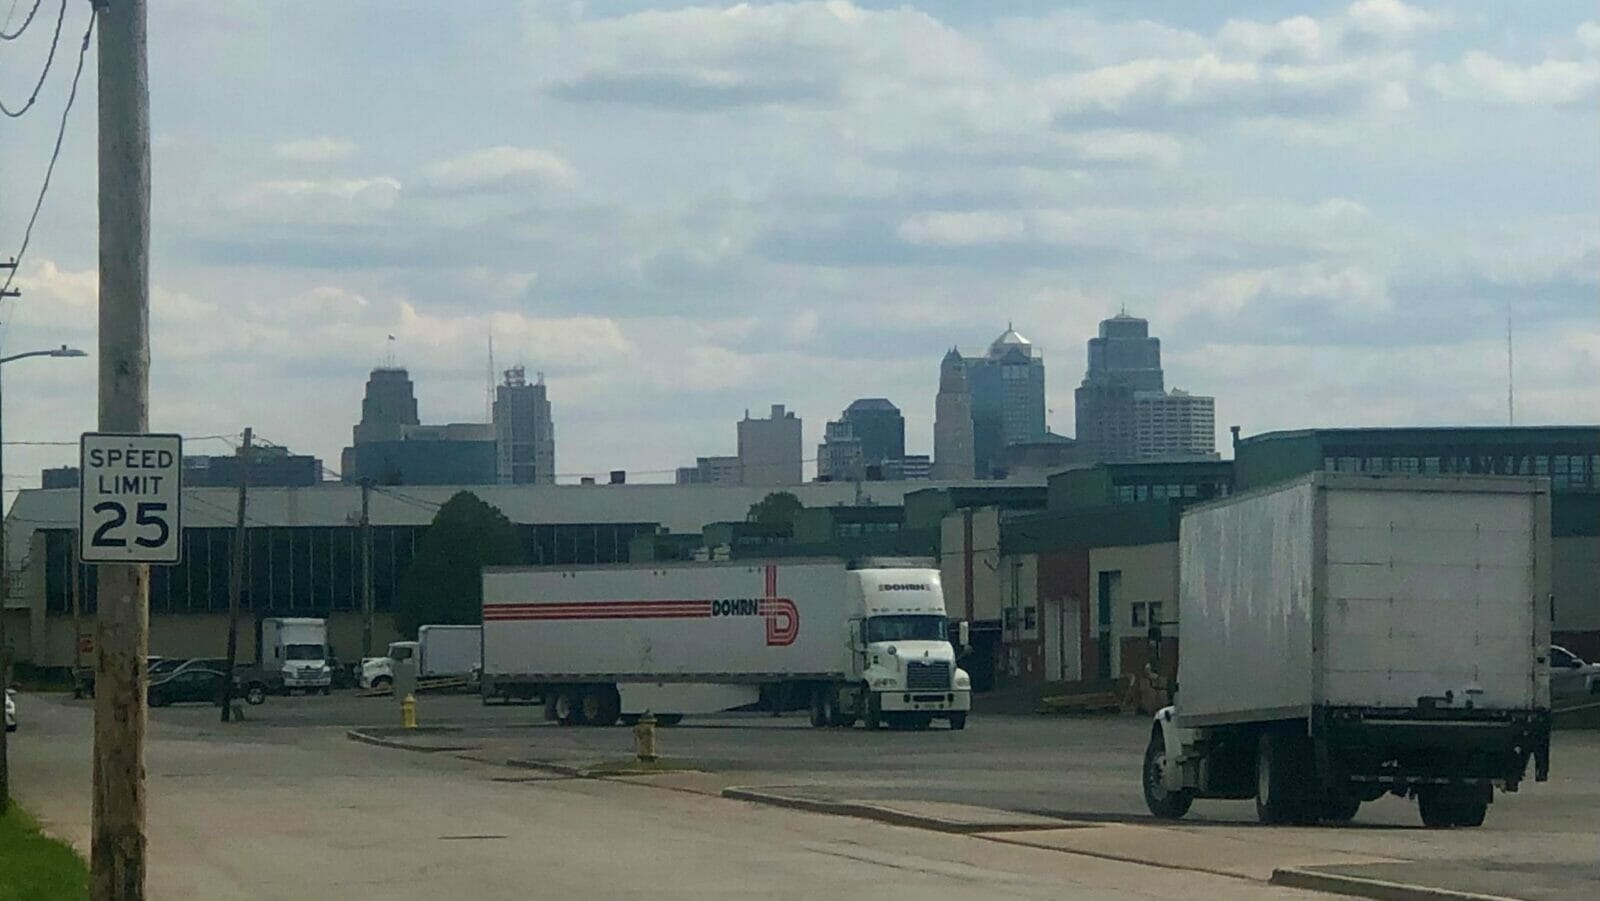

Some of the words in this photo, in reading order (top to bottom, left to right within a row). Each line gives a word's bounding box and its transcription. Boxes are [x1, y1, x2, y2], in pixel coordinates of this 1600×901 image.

[90, 449, 173, 469] SPEED
[99, 475, 163, 495] LIMIT
[92, 501, 169, 548] 25
[884, 584, 925, 592] DOHRN
[712, 599, 758, 616] DOHRN
